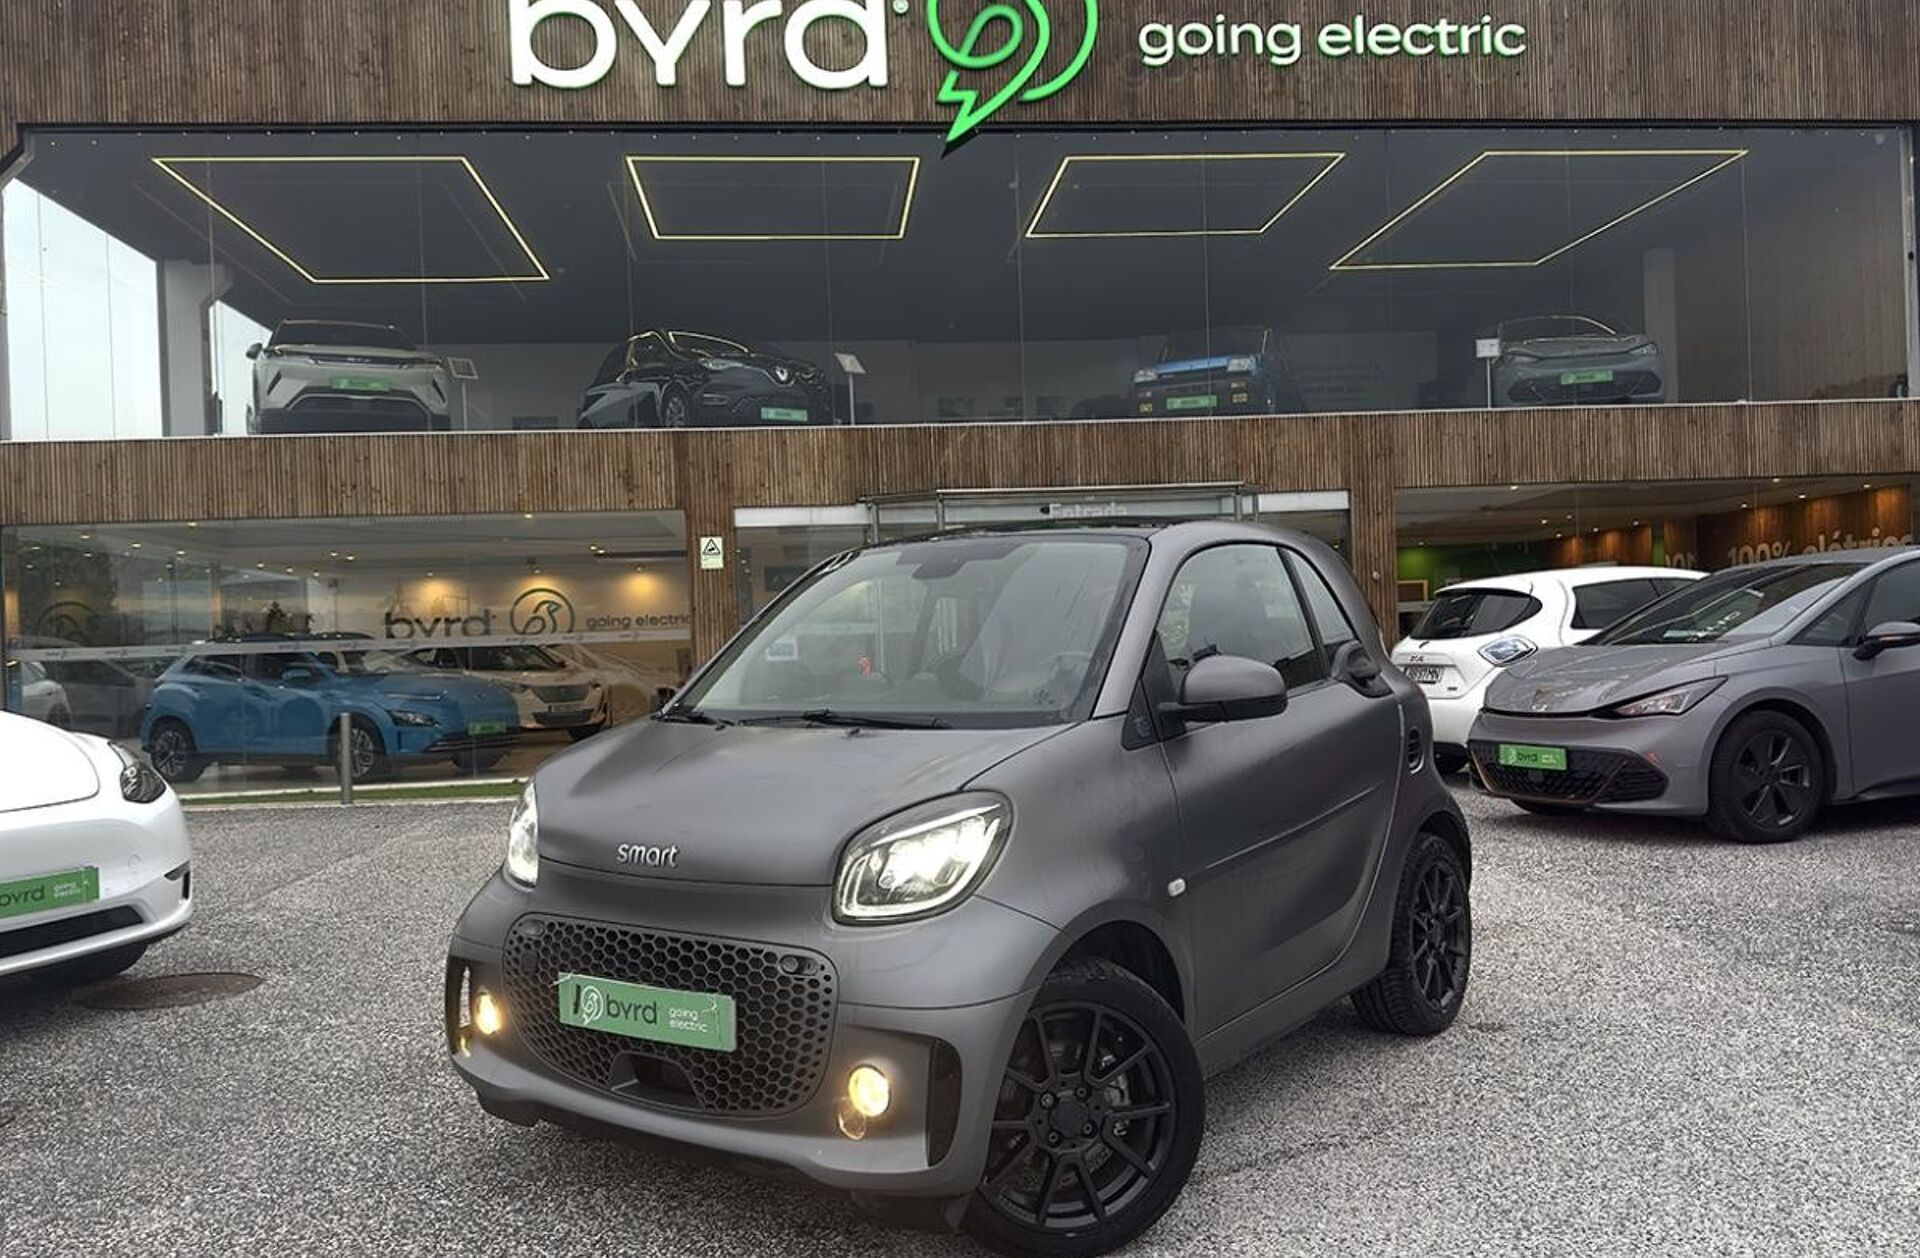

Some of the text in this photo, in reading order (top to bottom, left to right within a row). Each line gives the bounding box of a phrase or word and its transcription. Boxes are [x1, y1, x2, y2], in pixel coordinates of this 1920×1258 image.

[511, 0, 889, 88] byrd
[1138, 13, 1527, 66] going electric
[1049, 502, 1127, 518] Entrada
[385, 609, 490, 639] byrd
[587, 614, 632, 629] going
[617, 843, 678, 868] smart
[605, 993, 658, 1025] byrd
[668, 1006, 698, 1021] going
[669, 1018, 708, 1033] electric
